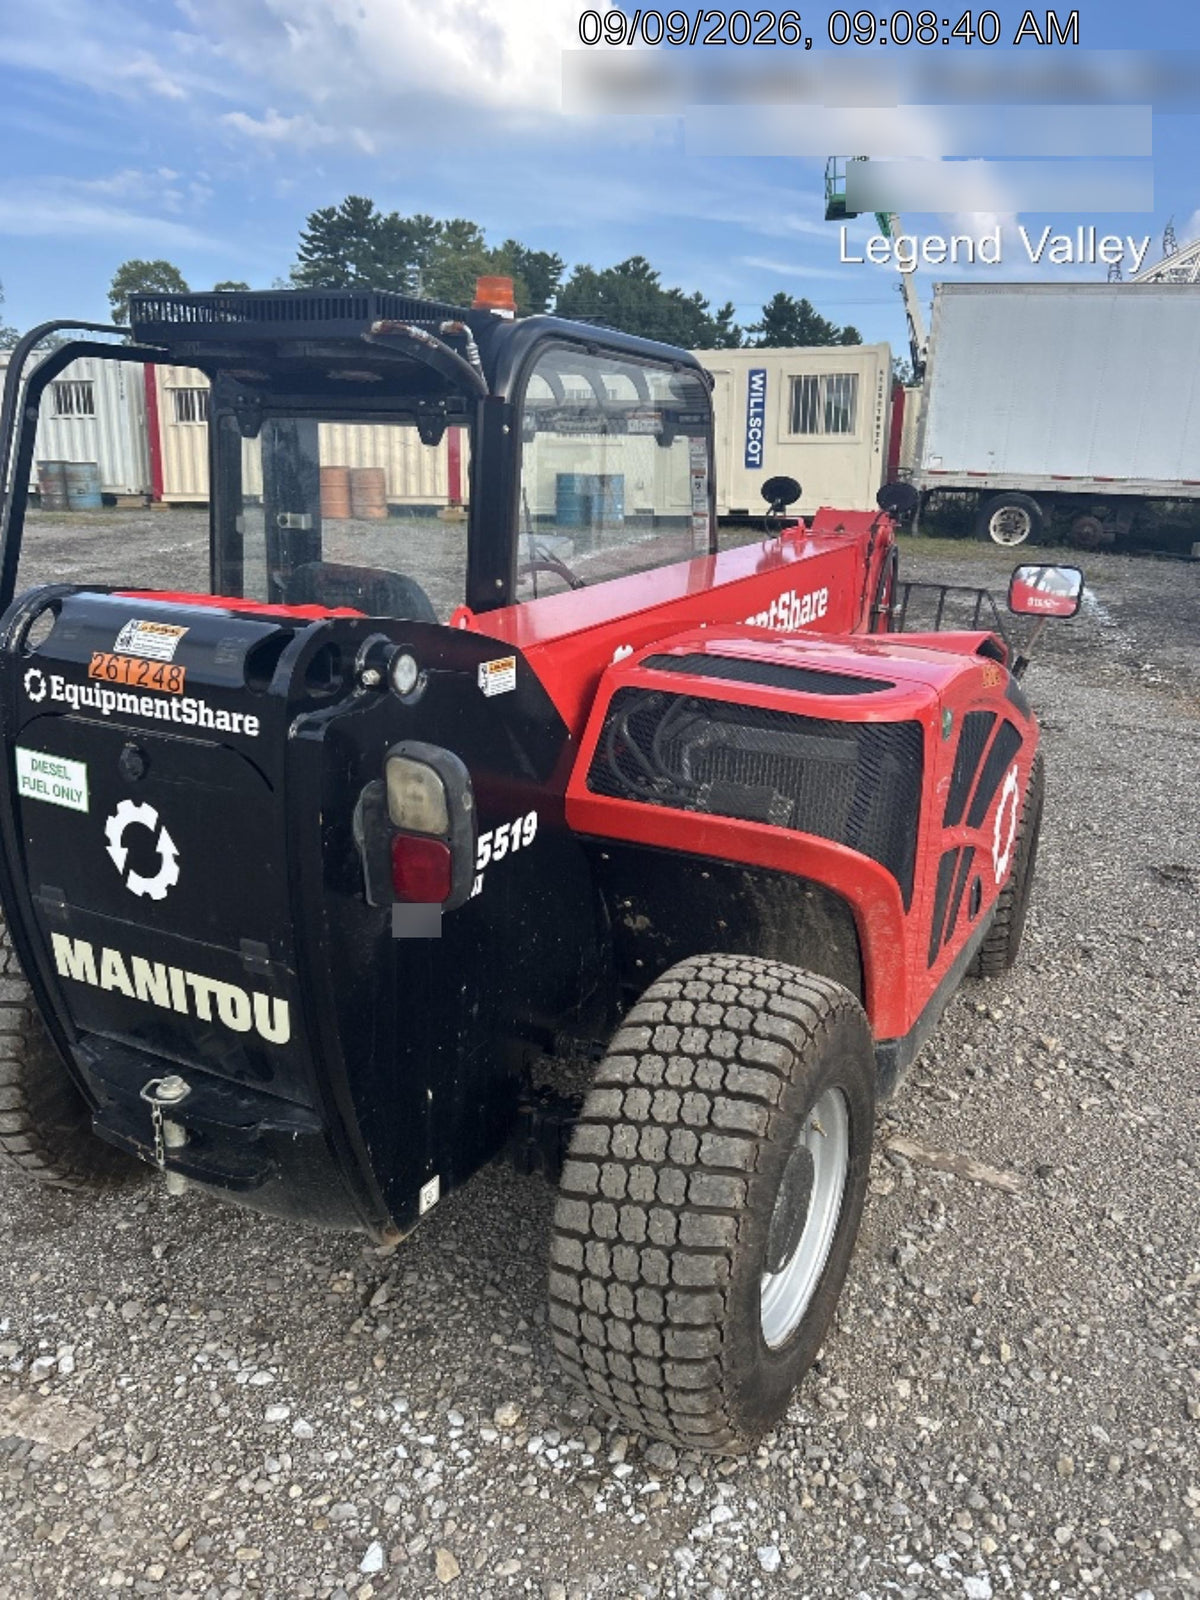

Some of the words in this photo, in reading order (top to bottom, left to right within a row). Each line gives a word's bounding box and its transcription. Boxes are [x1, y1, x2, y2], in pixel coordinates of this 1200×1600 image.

[747, 372, 765, 465] WILLSCOT
[91, 653, 182, 692] 261248
[50, 675, 260, 737] EquipmentShare
[22, 776, 50, 795] FUEL
[52, 783, 83, 804] ONLY
[31, 758, 71, 781] DIESEL
[476, 810, 538, 870] 5519
[51, 932, 290, 1045] MANITOU
